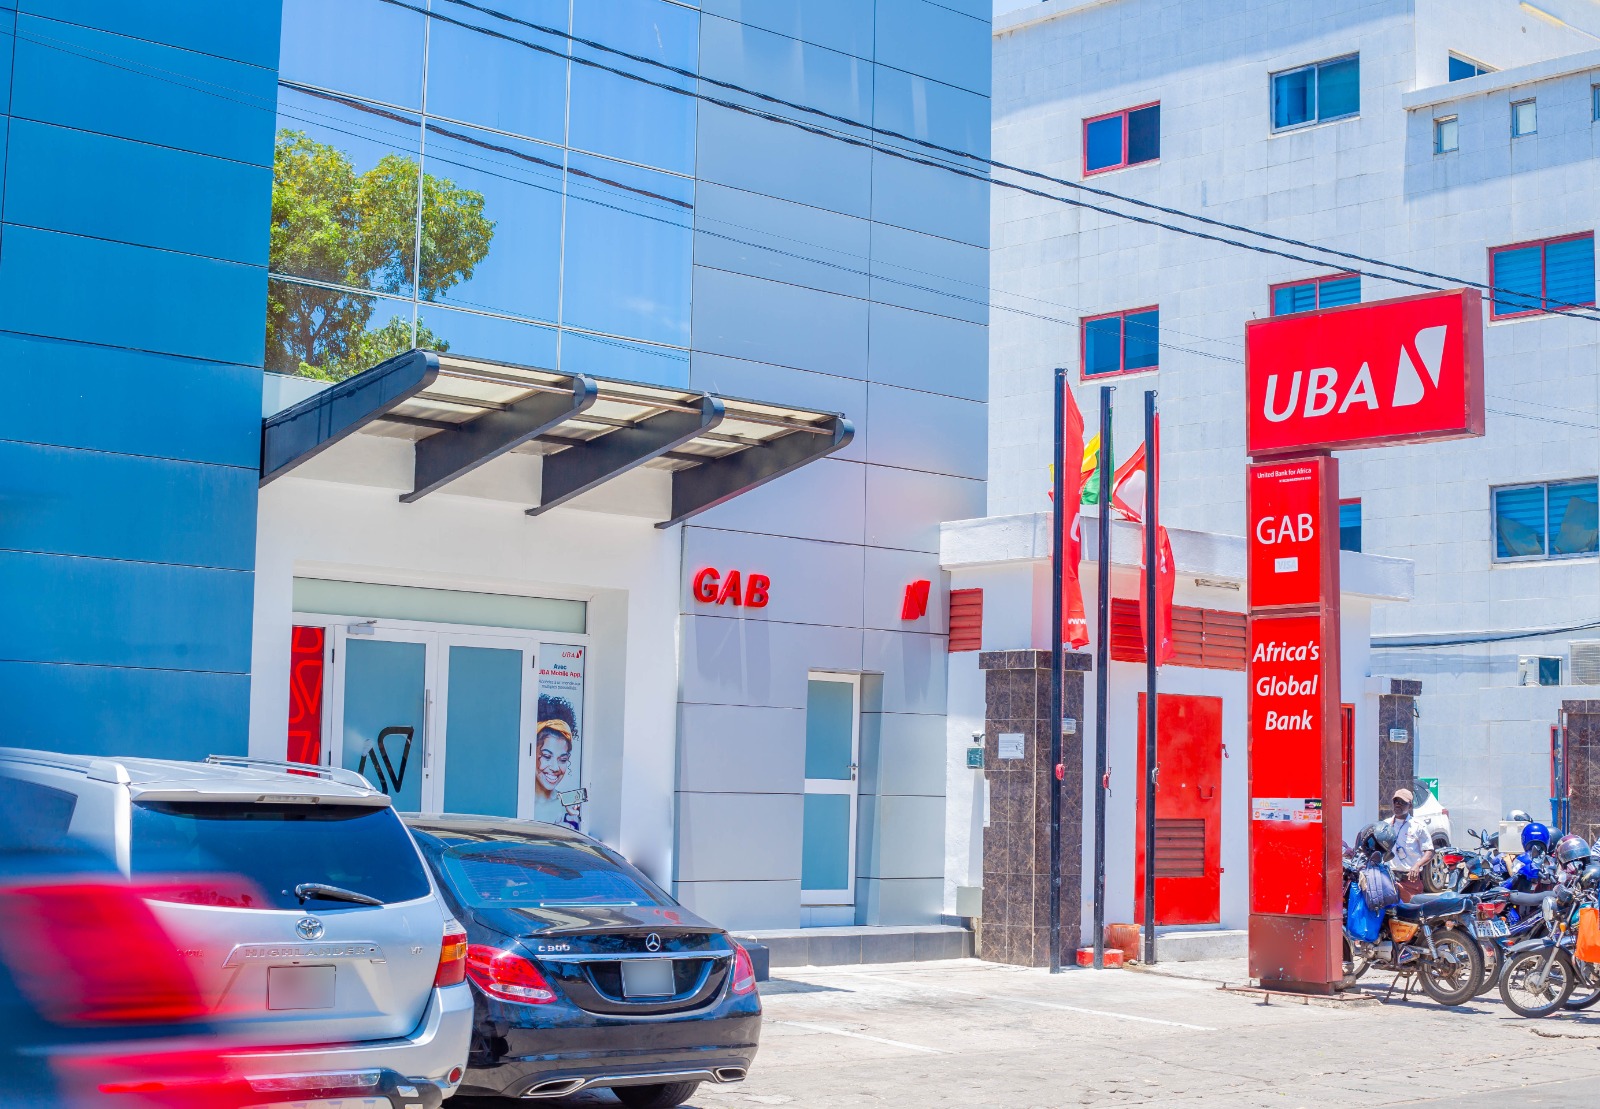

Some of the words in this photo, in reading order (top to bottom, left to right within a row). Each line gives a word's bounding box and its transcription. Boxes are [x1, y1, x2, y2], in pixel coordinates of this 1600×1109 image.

[1263, 361, 1379, 423] UBA
[1256, 471, 1275, 479] United
[1275, 470, 1288, 478] Bank
[1296, 467, 1312, 475] Africa
[1256, 513, 1314, 545] GAB
[693, 567, 770, 608] GAB
[1252, 640, 1320, 662] Africa's
[1256, 674, 1319, 697] Global
[1265, 709, 1314, 731] Bank
[245, 946, 367, 958] HIGHLANDER
[547, 944, 571, 952] 300
